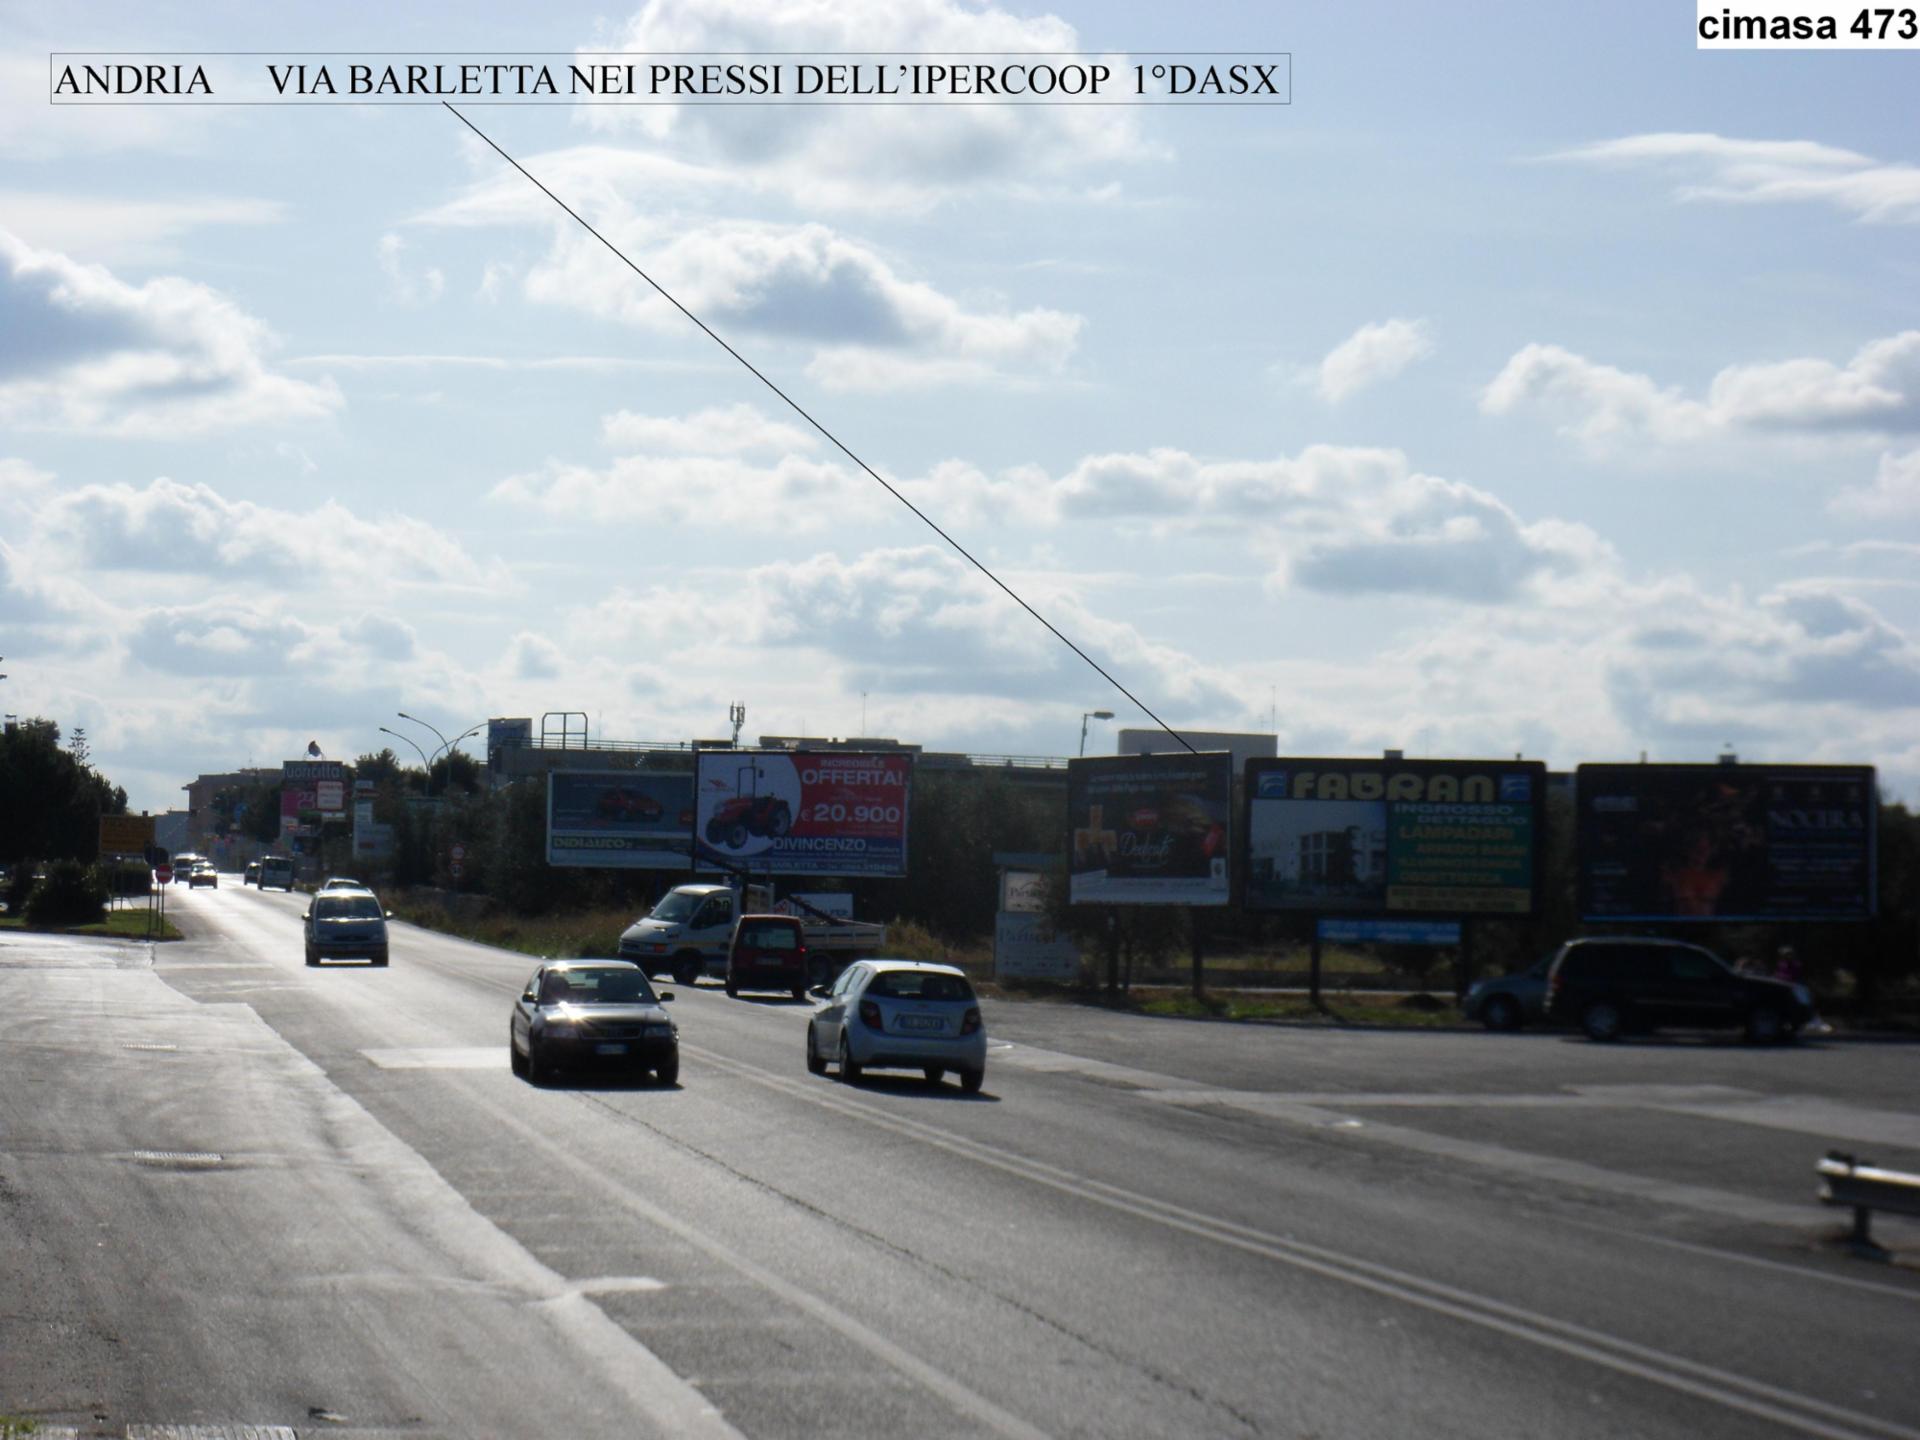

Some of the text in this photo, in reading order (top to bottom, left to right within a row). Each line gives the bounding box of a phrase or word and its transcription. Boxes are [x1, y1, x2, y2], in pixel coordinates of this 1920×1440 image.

[801, 768, 903, 786] OFFERTA!
[1292, 772, 1495, 802] FABRAN
[813, 804, 901, 823] 20.900
[1393, 803, 1514, 816] INGROSSO
[1417, 815, 1528, 825] DETTAGLIO
